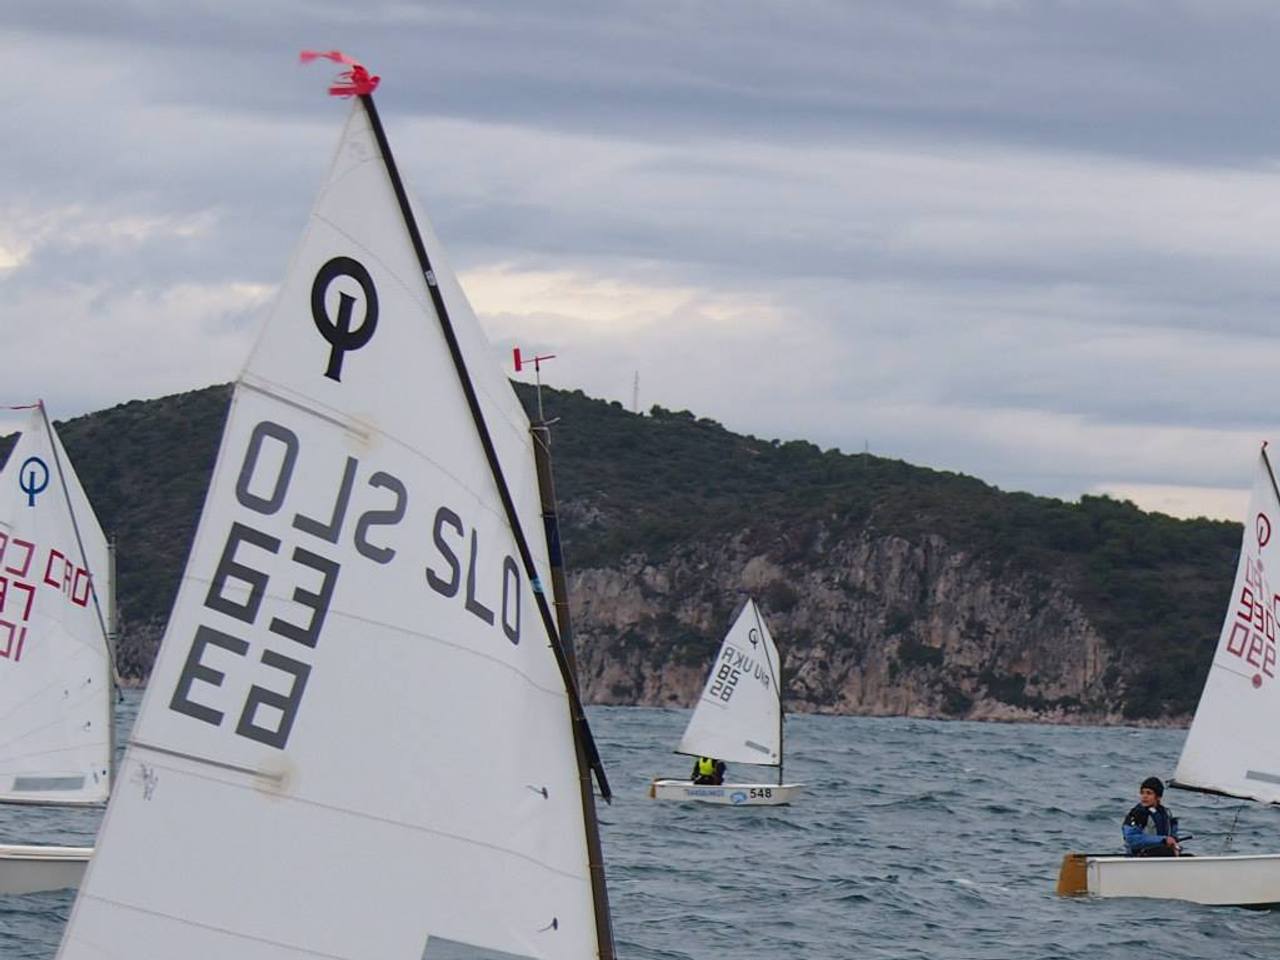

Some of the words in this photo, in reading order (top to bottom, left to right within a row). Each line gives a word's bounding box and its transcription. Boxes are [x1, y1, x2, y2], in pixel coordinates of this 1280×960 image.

[204, 521, 342, 649] 63
[425, 506, 521, 645] SLO
[750, 788, 772, 799] 548
